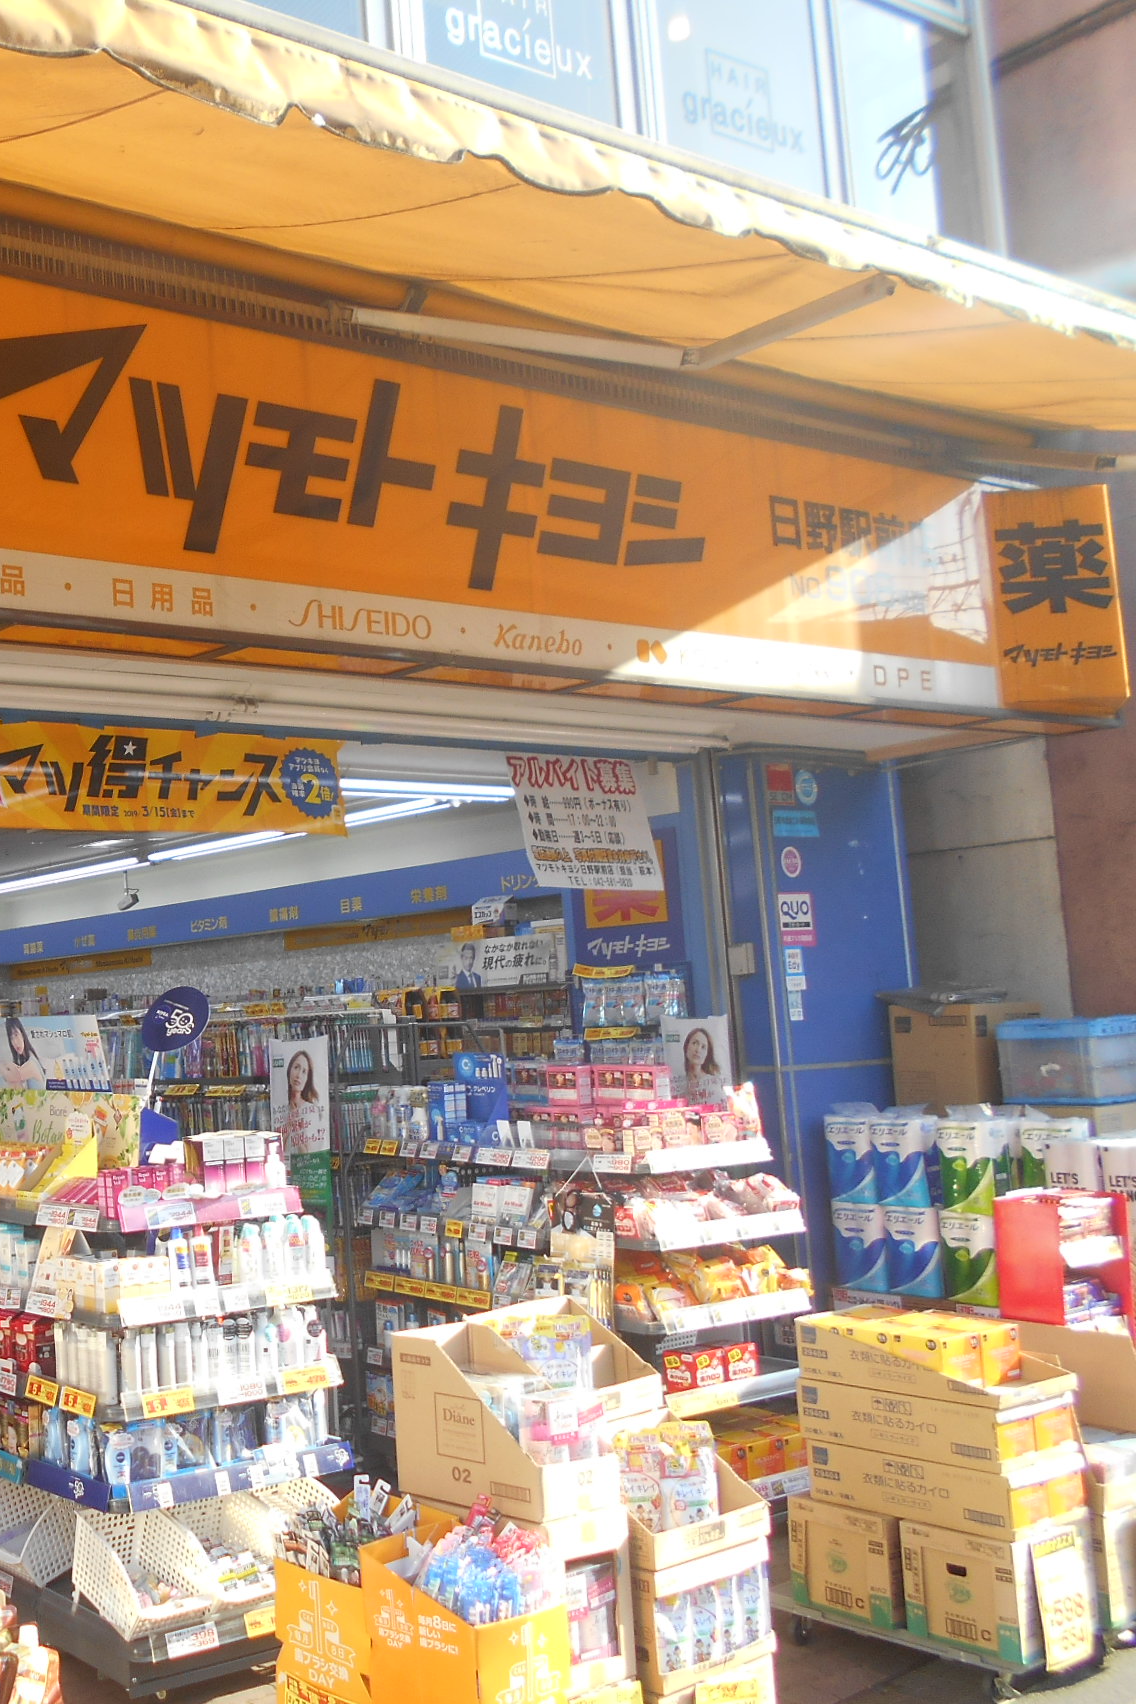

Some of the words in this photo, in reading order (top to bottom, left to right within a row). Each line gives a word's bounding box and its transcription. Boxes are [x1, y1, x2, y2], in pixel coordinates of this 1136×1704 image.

[994, 519, 1114, 615] 薬
[111, 577, 214, 617] 日用品
[288, 599, 432, 641] SHISEIDO
[492, 622, 583, 657] Kanebo
[873, 664, 934, 692] DPE
[1003, 642, 1118, 668] マツモトキヨシ
[505, 755, 637, 796] アルバイト募集
[83, 804, 120, 817] 期間限定
[410, 885, 448, 904] 栄養剤
[340, 896, 362, 914] 目薬
[780, 900, 809, 920] QUO
[190, 916, 228, 933] ビタミン剤
[484, 940, 544, 954] なかなか取れない
[587, 933, 671, 960] マツモトキヨシ
[482, 951, 547, 971] 現代の疲れに。
[166, 1023, 192, 1037] years
[473, 1085, 496, 1094] クレベリン
[827, 1125, 864, 1135] エリエール
[870, 1126, 907, 1136] エリエール
[937, 1131, 975, 1140] エリエール
[1050, 1171, 1079, 1185] LET'S
[834, 1212, 875, 1222] エリエール
[885, 1214, 924, 1225] エリエール
[941, 1221, 979, 1231] エリエール
[851, 1410, 937, 1434] 衣類に貼るカイロ
[451, 1466, 472, 1485] 02
[577, 1470, 593, 1486] 02
[862, 1473, 950, 1498] 衣類に貼るカイロ
[855, 1597, 864, 1609] C
[418, 1615, 457, 1632] 毎月8日に
[419, 1626, 441, 1639] 新しい
[980, 1629, 991, 1642] C
[387, 1640, 405, 1649] DAY
[308, 1669, 336, 1689] DAY
